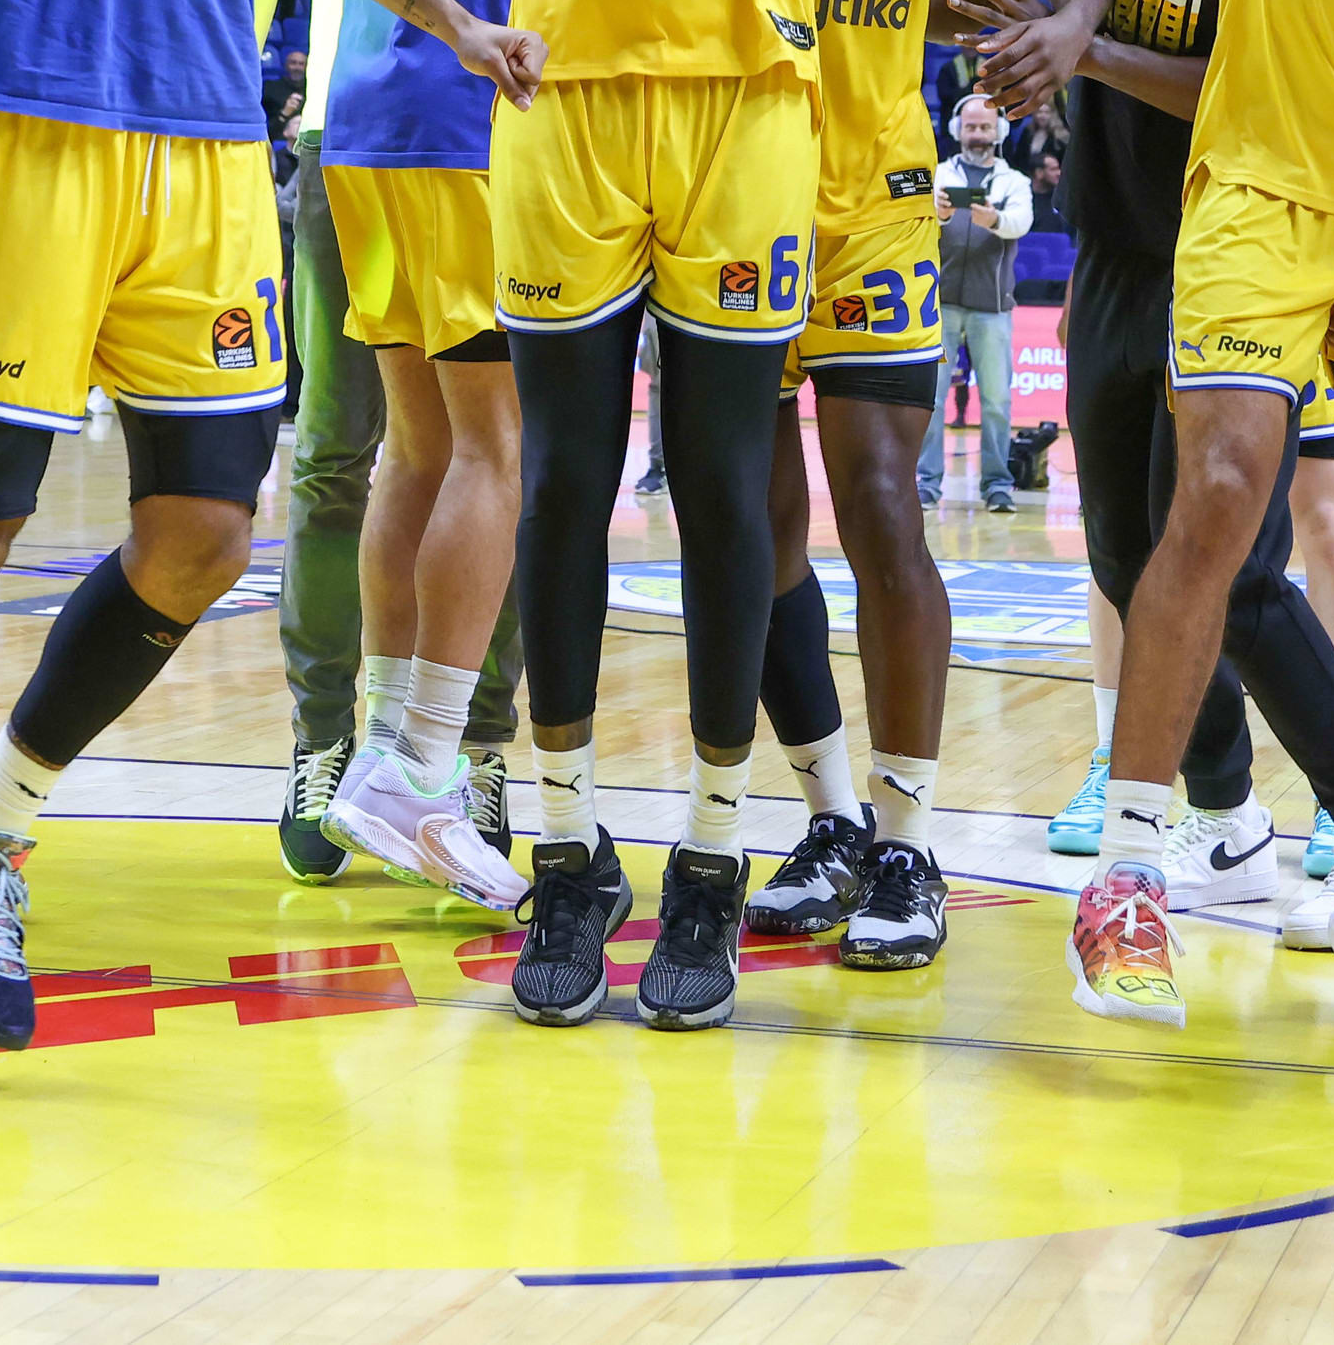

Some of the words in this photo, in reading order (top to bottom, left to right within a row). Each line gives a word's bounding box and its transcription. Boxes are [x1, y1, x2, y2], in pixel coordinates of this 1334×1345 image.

[508, 276, 562, 302] Rapyd
[768, 235, 799, 311] 6
[862, 259, 940, 334] 32
[255, 276, 283, 363] 1
[1218, 334, 1282, 361] Rapyd
